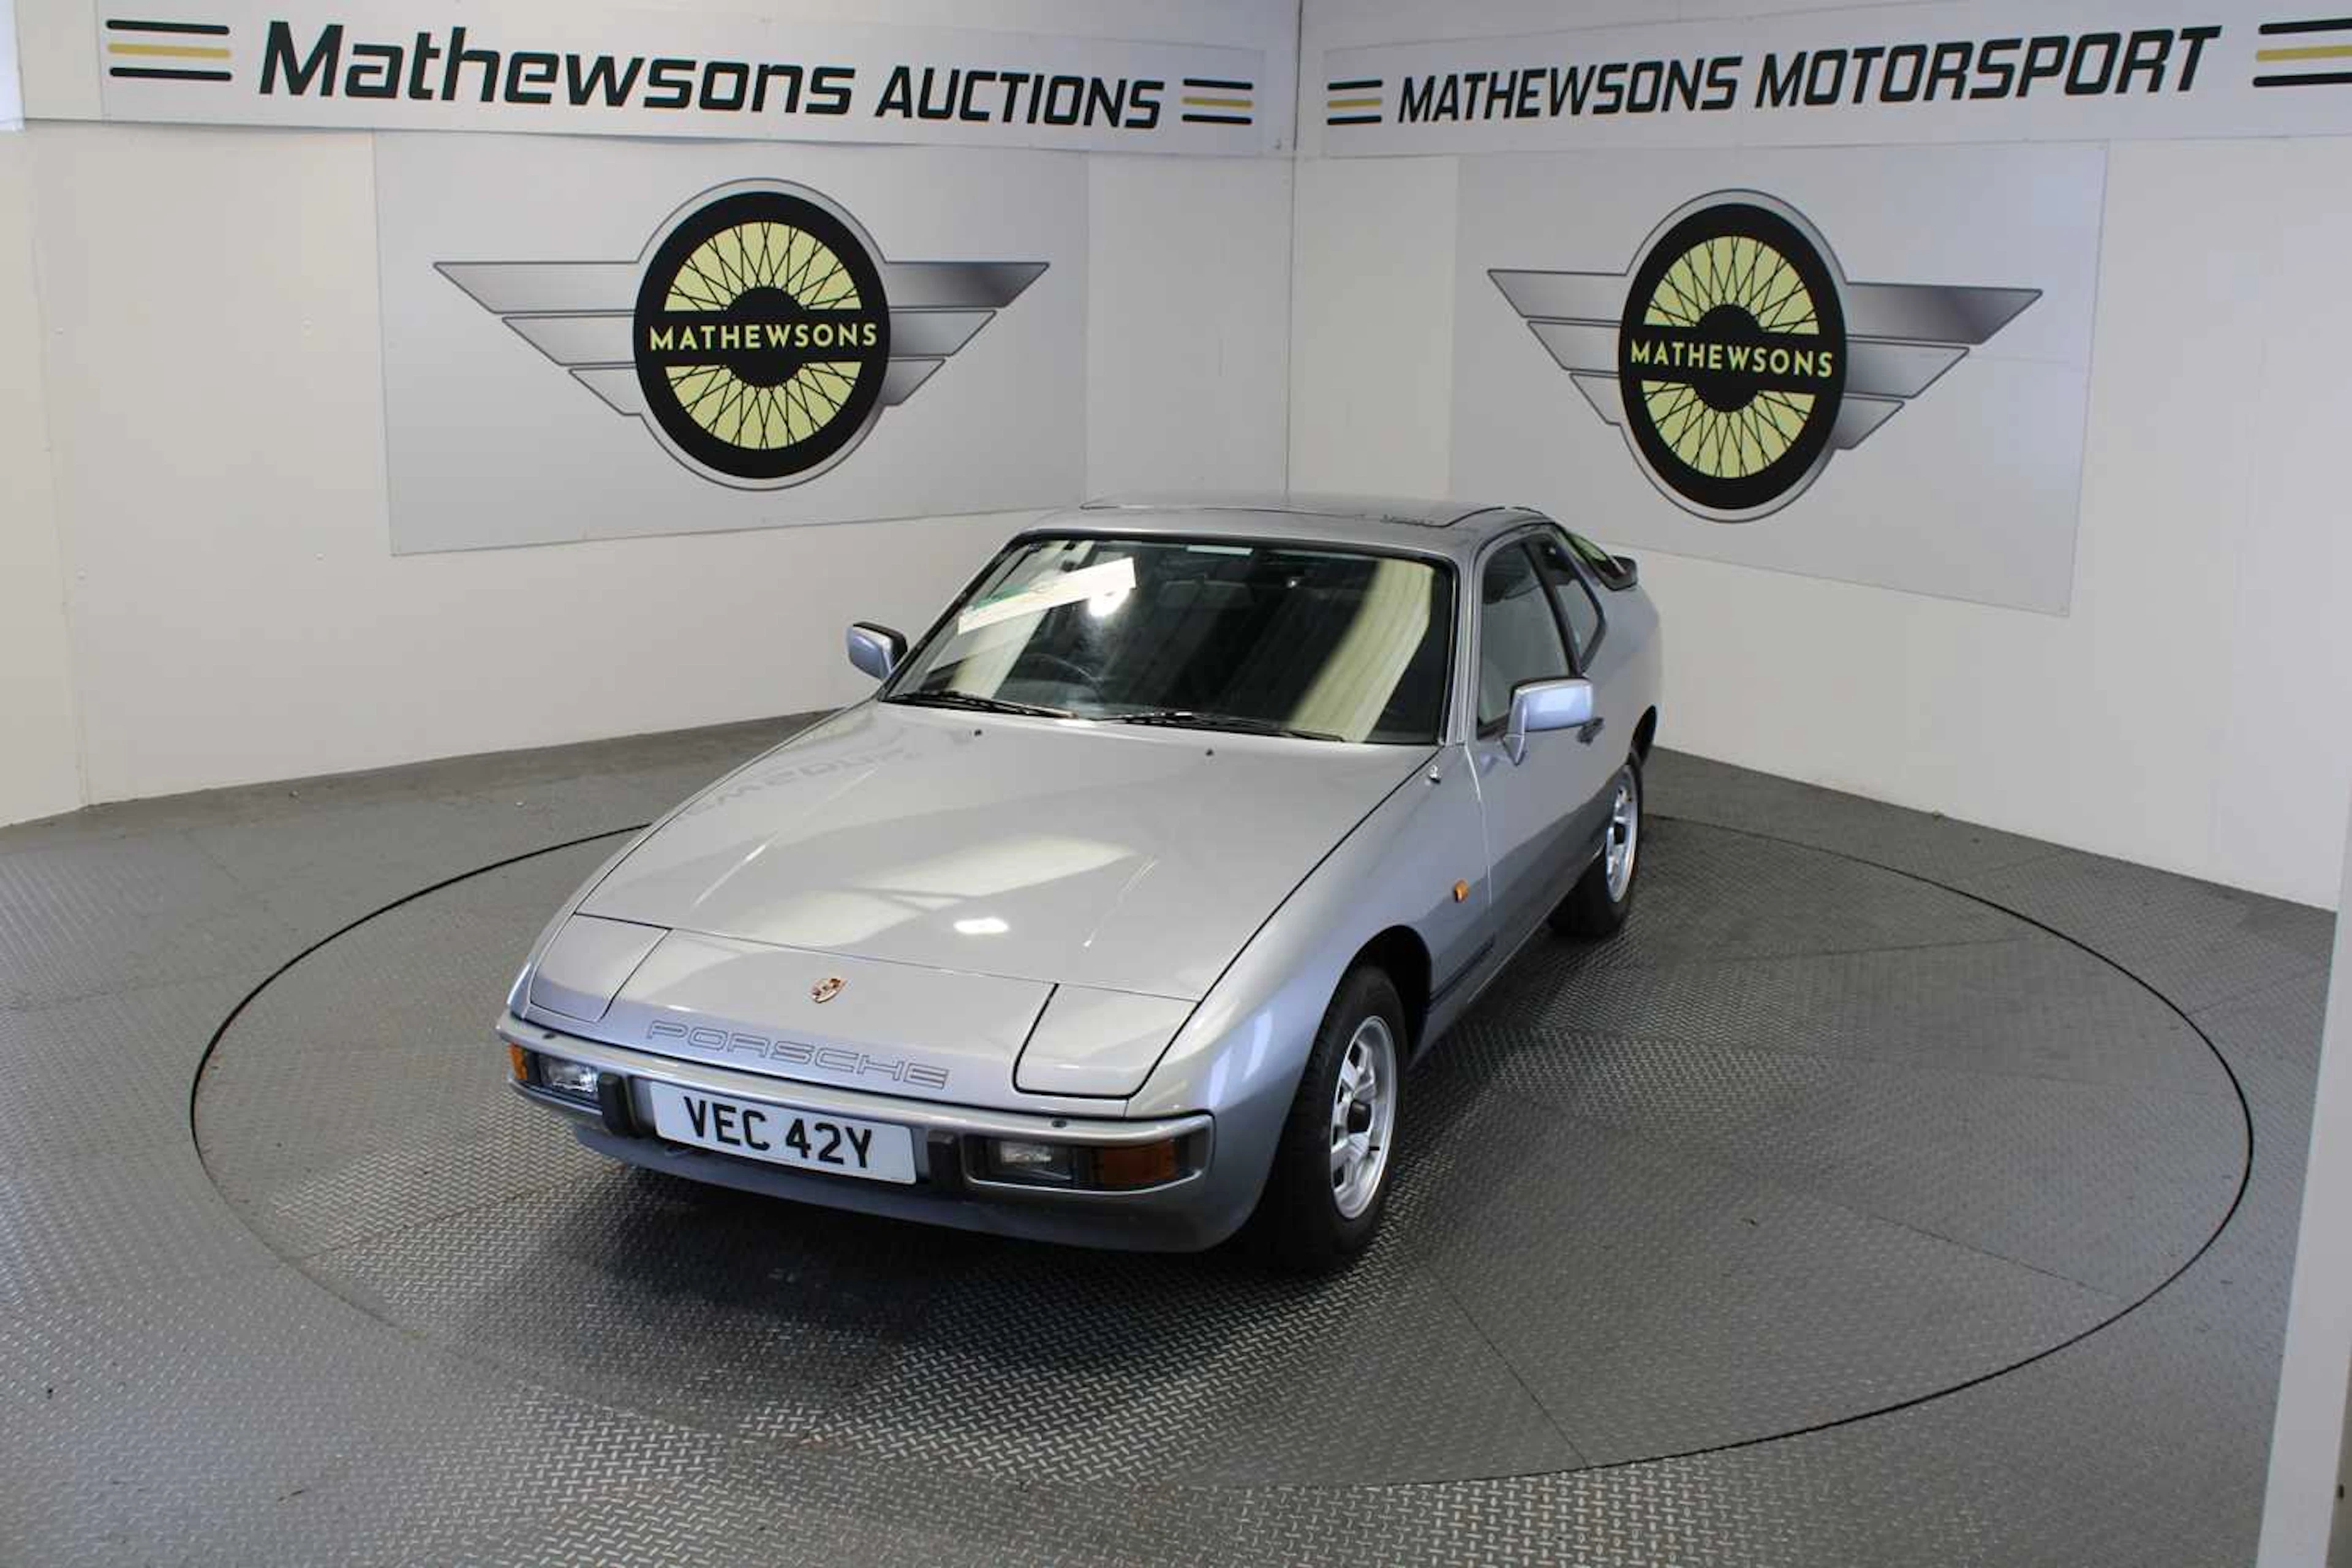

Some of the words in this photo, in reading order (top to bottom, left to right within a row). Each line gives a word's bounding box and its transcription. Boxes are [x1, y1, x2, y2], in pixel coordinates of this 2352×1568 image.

[259, 21, 856, 116] Mathewsons
[874, 66, 1166, 130] AUCTIONS
[1397, 55, 1744, 124] MATHEWSONS
[1754, 24, 2223, 108] MOTORSPORT
[649, 322, 877, 350] MATHEWSONS
[1630, 339, 1834, 379] MATHEWSONS
[647, 1020, 949, 1090] PORSCHE
[683, 1095, 771, 1152] VEC
[785, 1118, 873, 1169] 42Y
